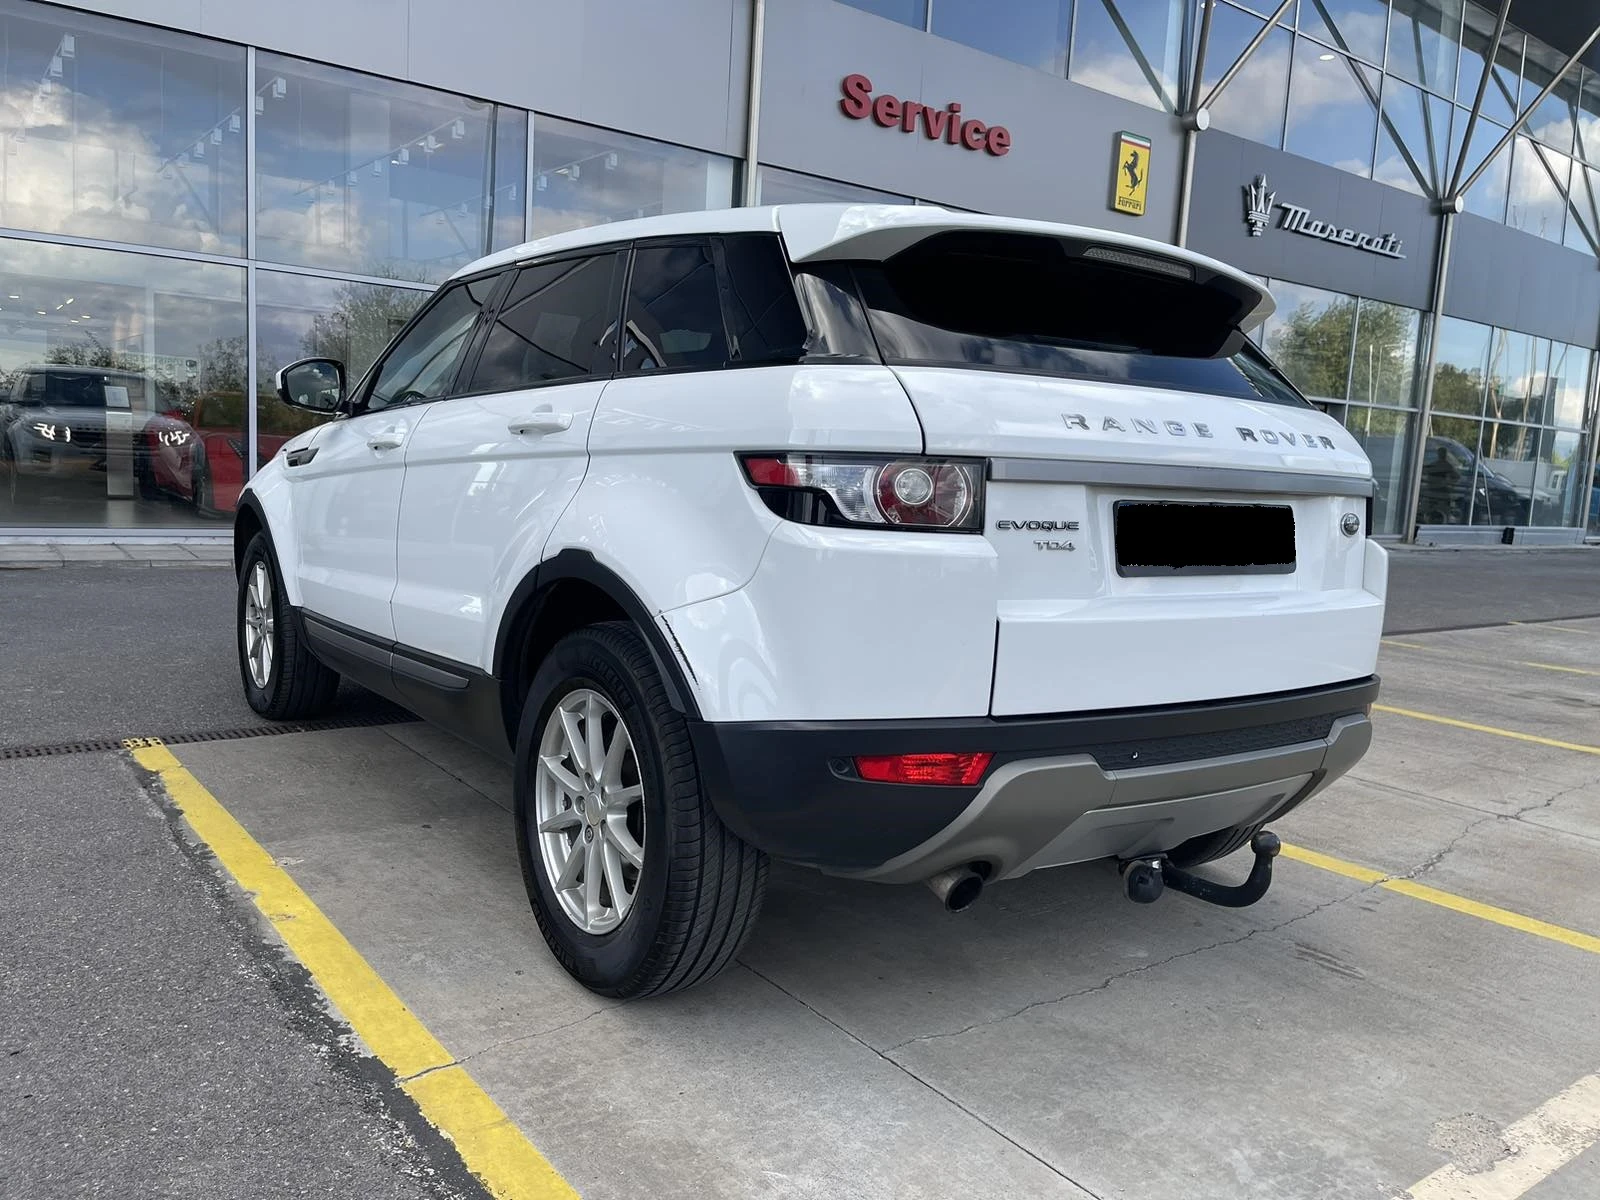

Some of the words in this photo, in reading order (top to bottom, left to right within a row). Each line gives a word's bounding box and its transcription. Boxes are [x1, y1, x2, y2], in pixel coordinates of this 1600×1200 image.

[840, 73, 1011, 157] Service
[1118, 196, 1142, 211] Ferrari
[1281, 202, 1407, 259] Maserati
[1061, 412, 1213, 438] RANGE
[1235, 426, 1336, 450] ROVER
[996, 520, 1079, 532] EVOQUE
[1033, 540, 1076, 552] TD4
